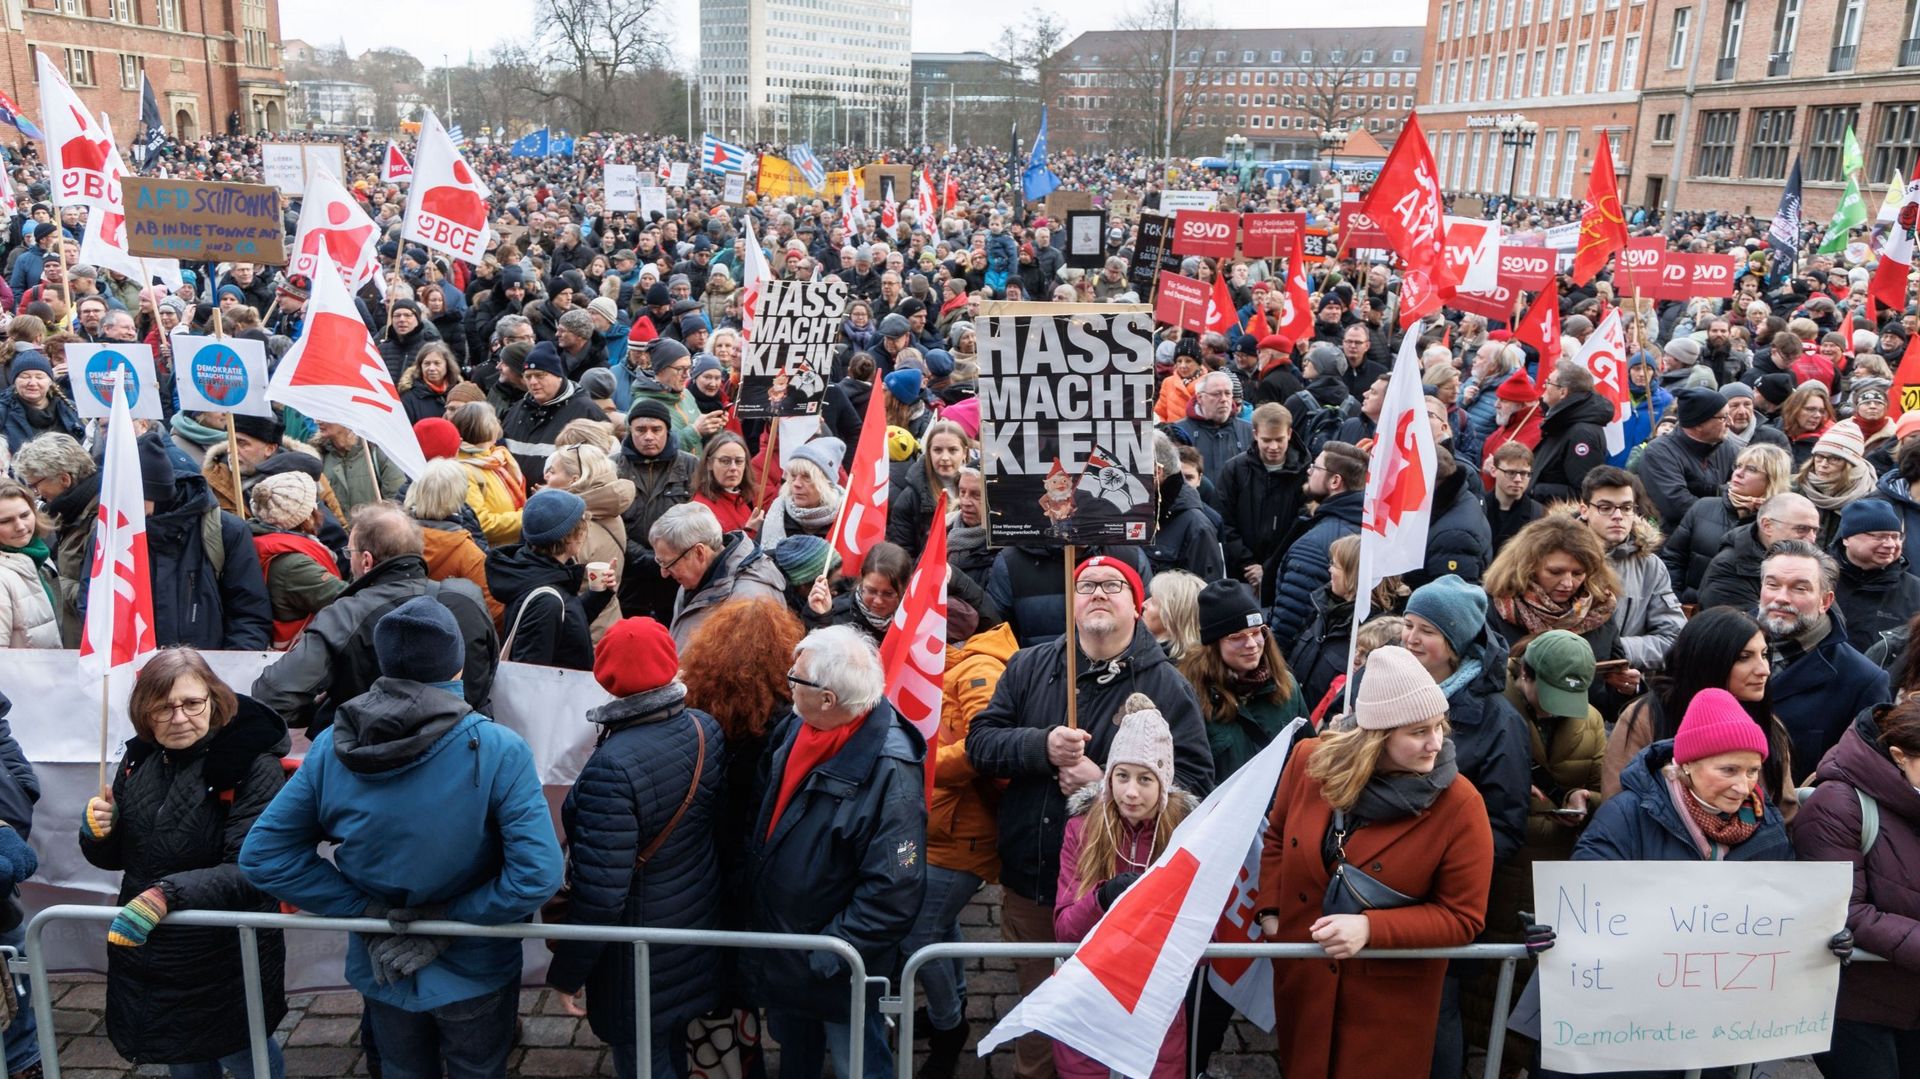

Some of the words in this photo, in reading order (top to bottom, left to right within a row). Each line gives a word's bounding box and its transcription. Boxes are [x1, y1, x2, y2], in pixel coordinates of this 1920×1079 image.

[137, 186, 190, 209] AFD
[135, 221, 158, 236] AB
[163, 223, 179, 236] IN
[180, 223, 202, 237] DIE
[204, 223, 256, 238] TONNE
[434, 220, 479, 256] BCE
[1144, 222, 1162, 238] FCK
[1444, 245, 1484, 267] EW
[754, 279, 848, 318] HASS
[750, 316, 842, 343] MACHT
[978, 312, 1154, 375] HASS
[196, 364, 243, 375] DEMOKRATIE
[743, 343, 836, 376] KLEIN
[978, 374, 1154, 420] MACHT
[983, 420, 1154, 476] KLEIN
[1555, 883, 1629, 937] Nie
[1572, 959, 1614, 990] ist
[1657, 950, 1791, 991] JETZT
[1553, 1020, 1698, 1047] Demokratie
